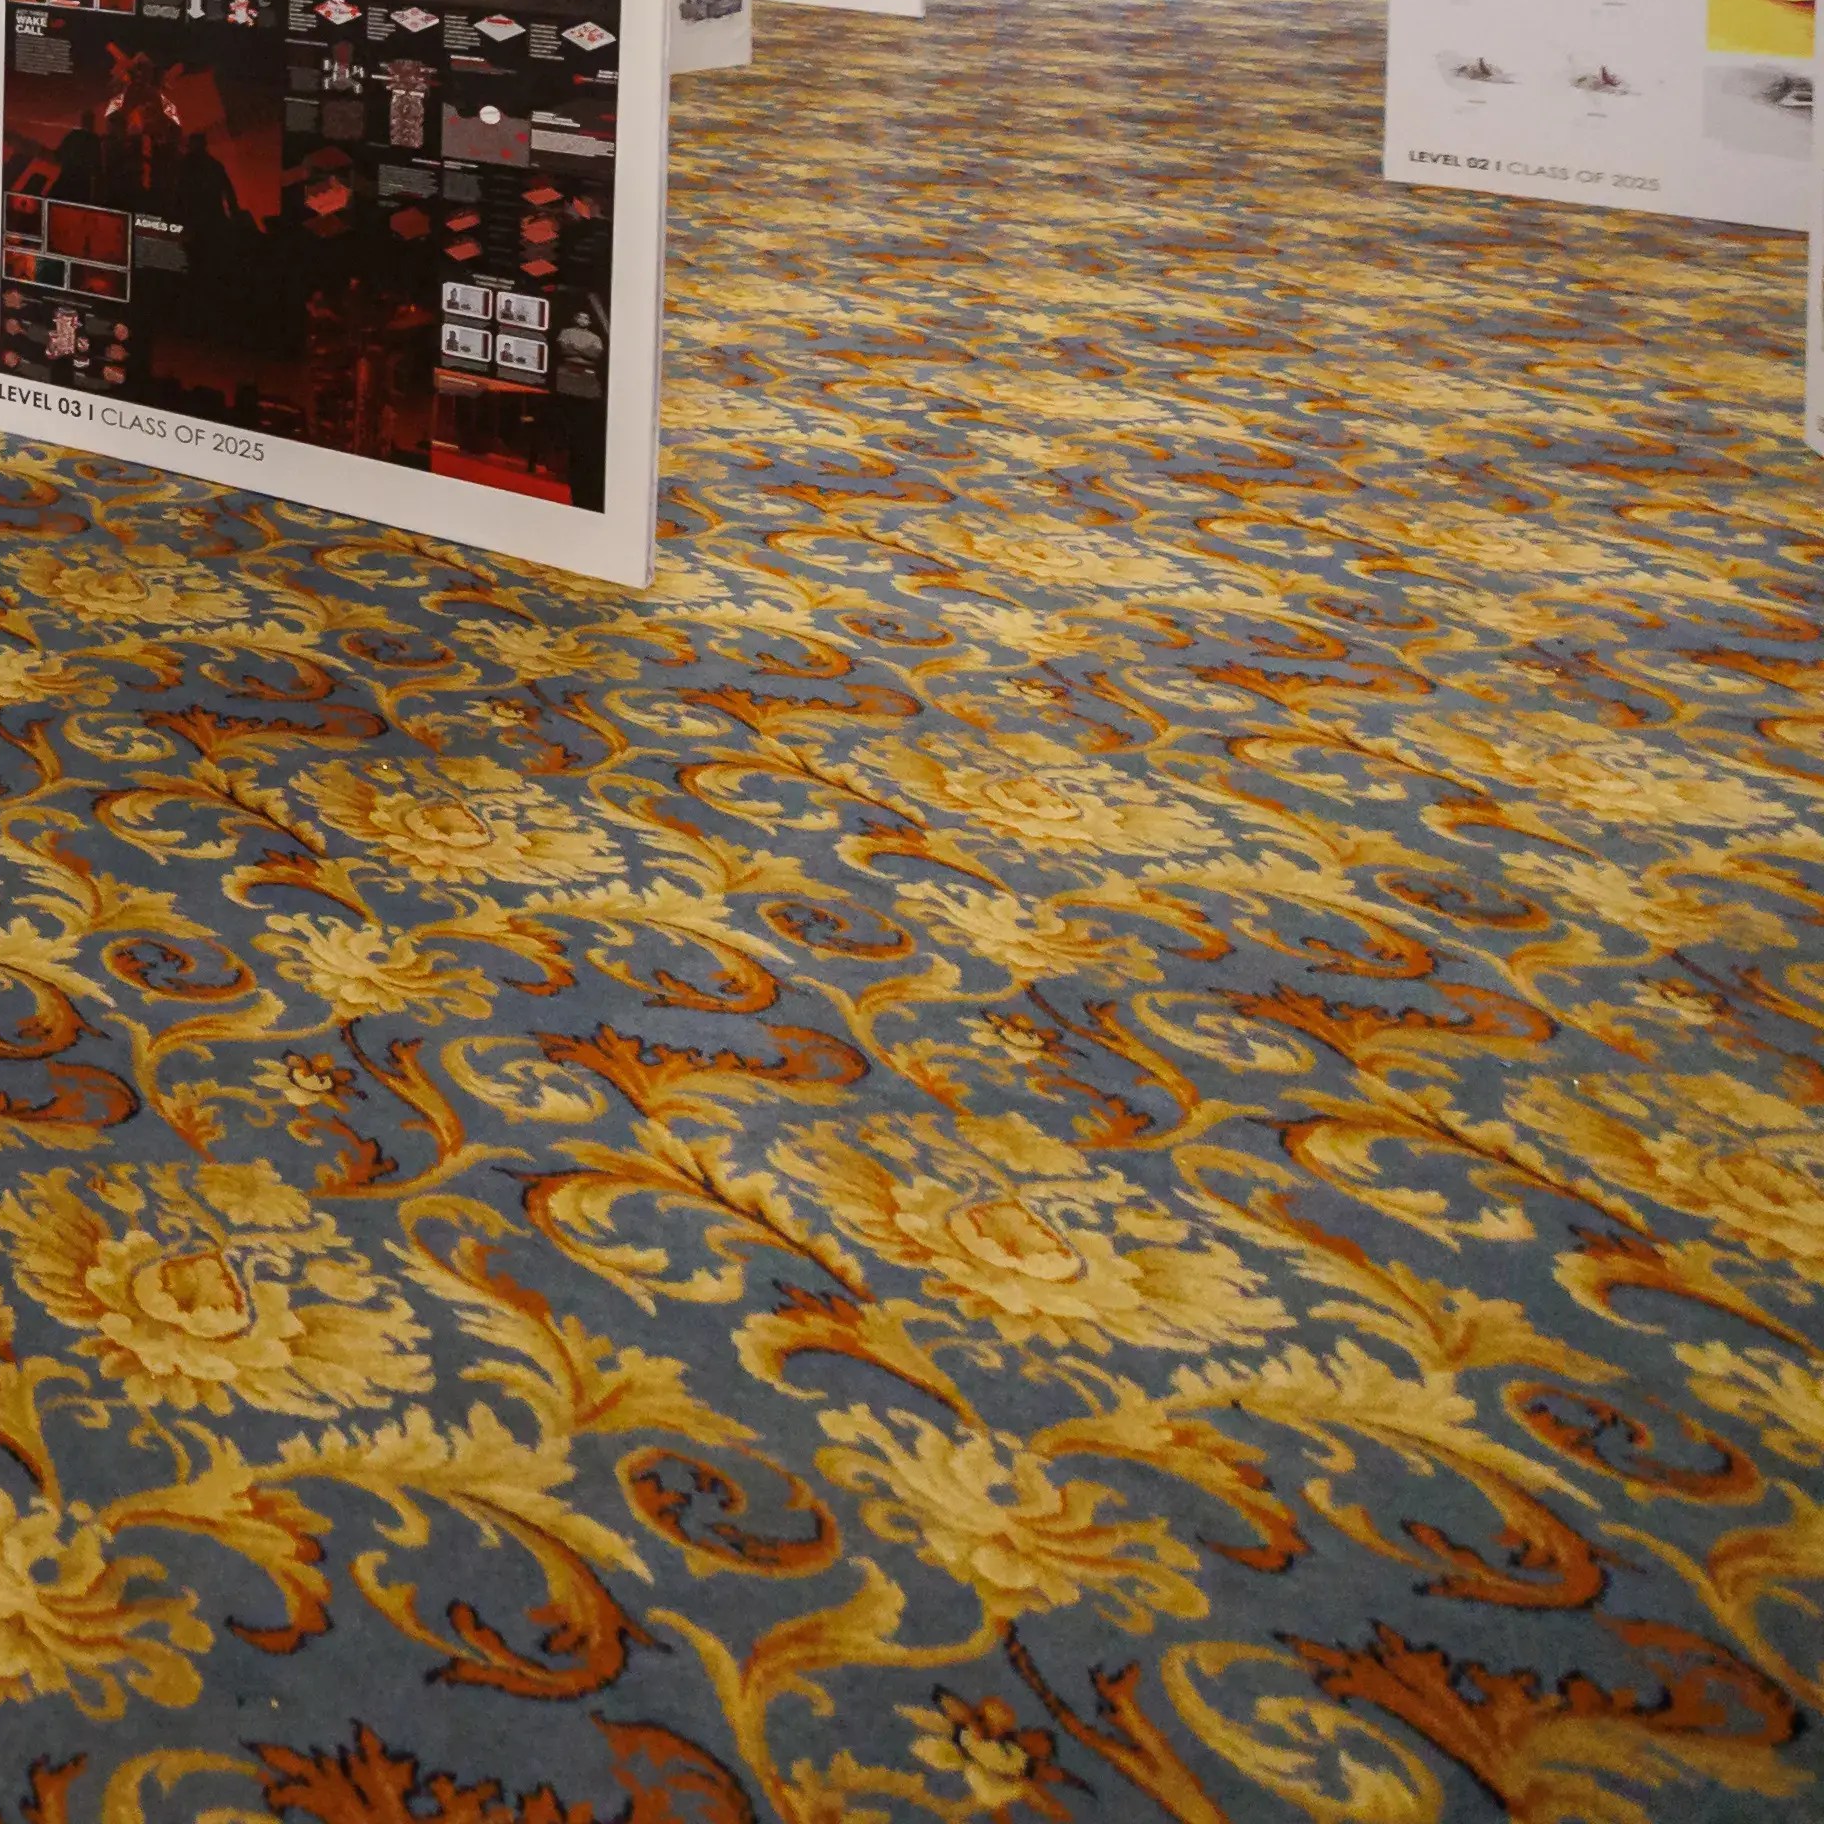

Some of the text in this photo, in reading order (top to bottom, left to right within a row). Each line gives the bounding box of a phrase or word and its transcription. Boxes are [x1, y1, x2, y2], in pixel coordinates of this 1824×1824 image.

[16, 15, 49, 28] WAKE
[16, 24, 45, 36] CALL
[1409, 149, 1461, 167] LEVEL
[1576, 170, 1604, 183] OF
[58, 397, 82, 418] 03
[101, 407, 167, 438] CLASS
[175, 425, 205, 446] OF
[212, 433, 265, 462] 2025
